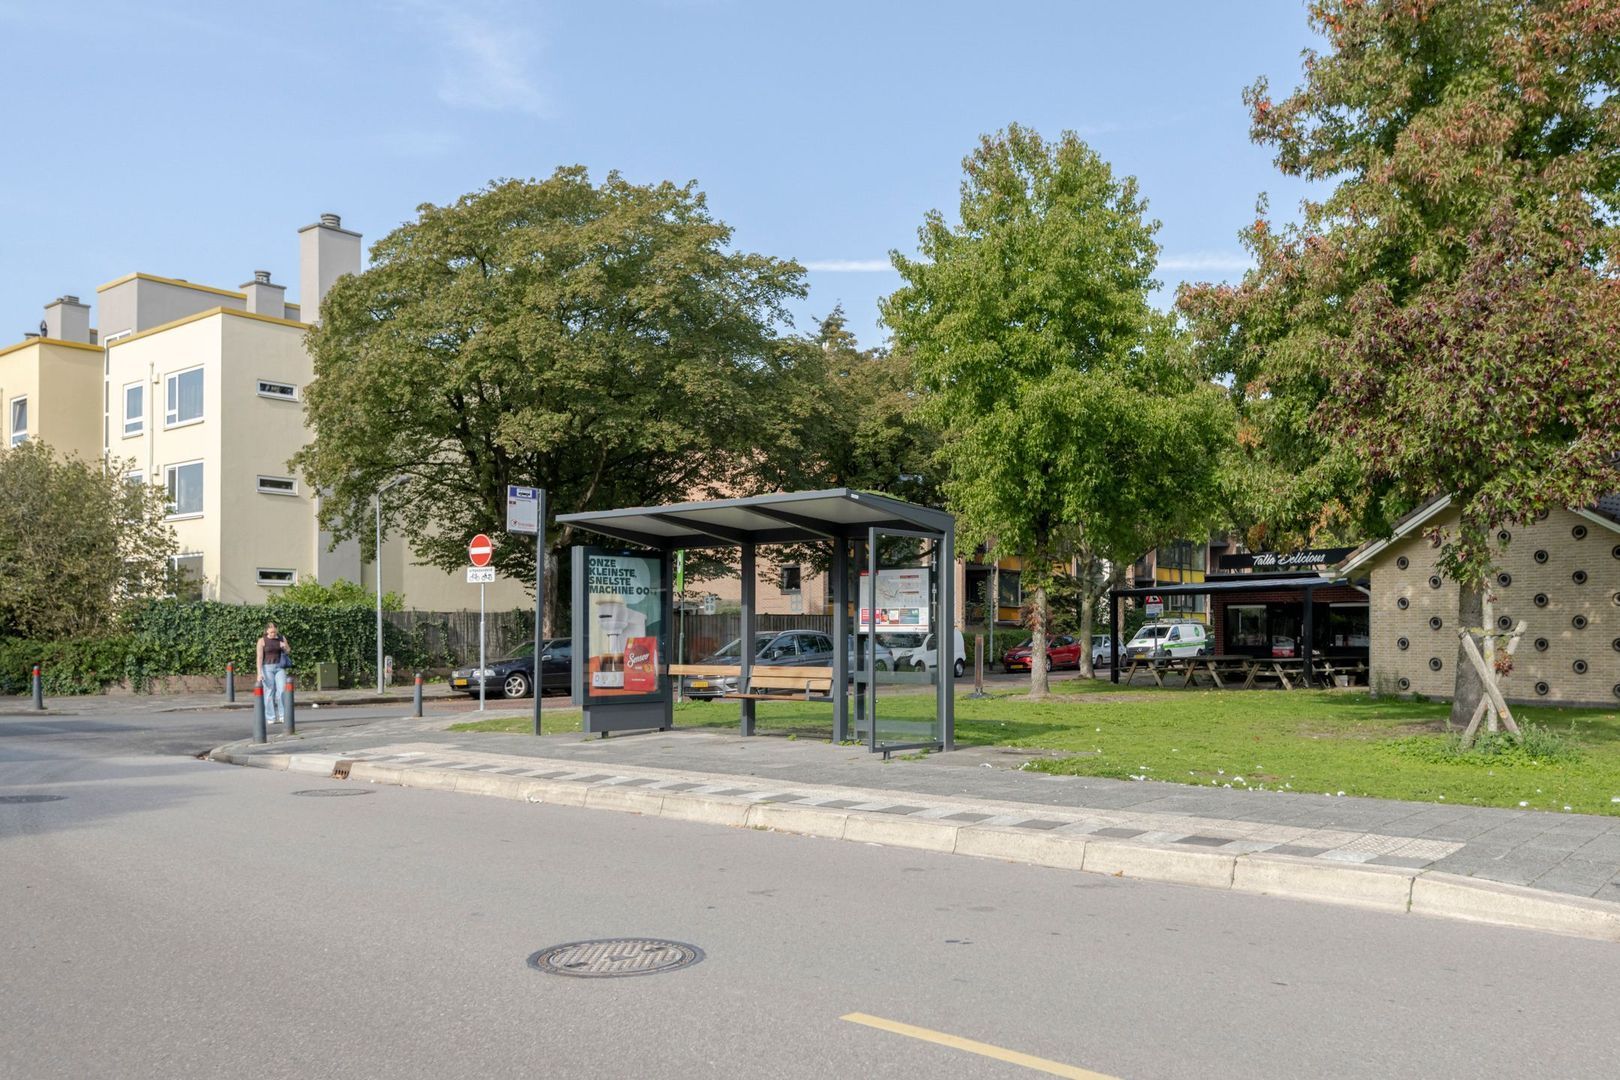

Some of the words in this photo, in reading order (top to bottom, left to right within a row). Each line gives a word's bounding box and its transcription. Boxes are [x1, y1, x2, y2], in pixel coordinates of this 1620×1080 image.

[589, 558, 617, 568] ONZE
[1252, 553, 1276, 566] Talia
[1277, 551, 1326, 565] Delicious
[589, 567, 637, 578] KLEINSTE,
[589, 576, 631, 586] SNELSTE
[589, 585, 635, 595] MACHINE
